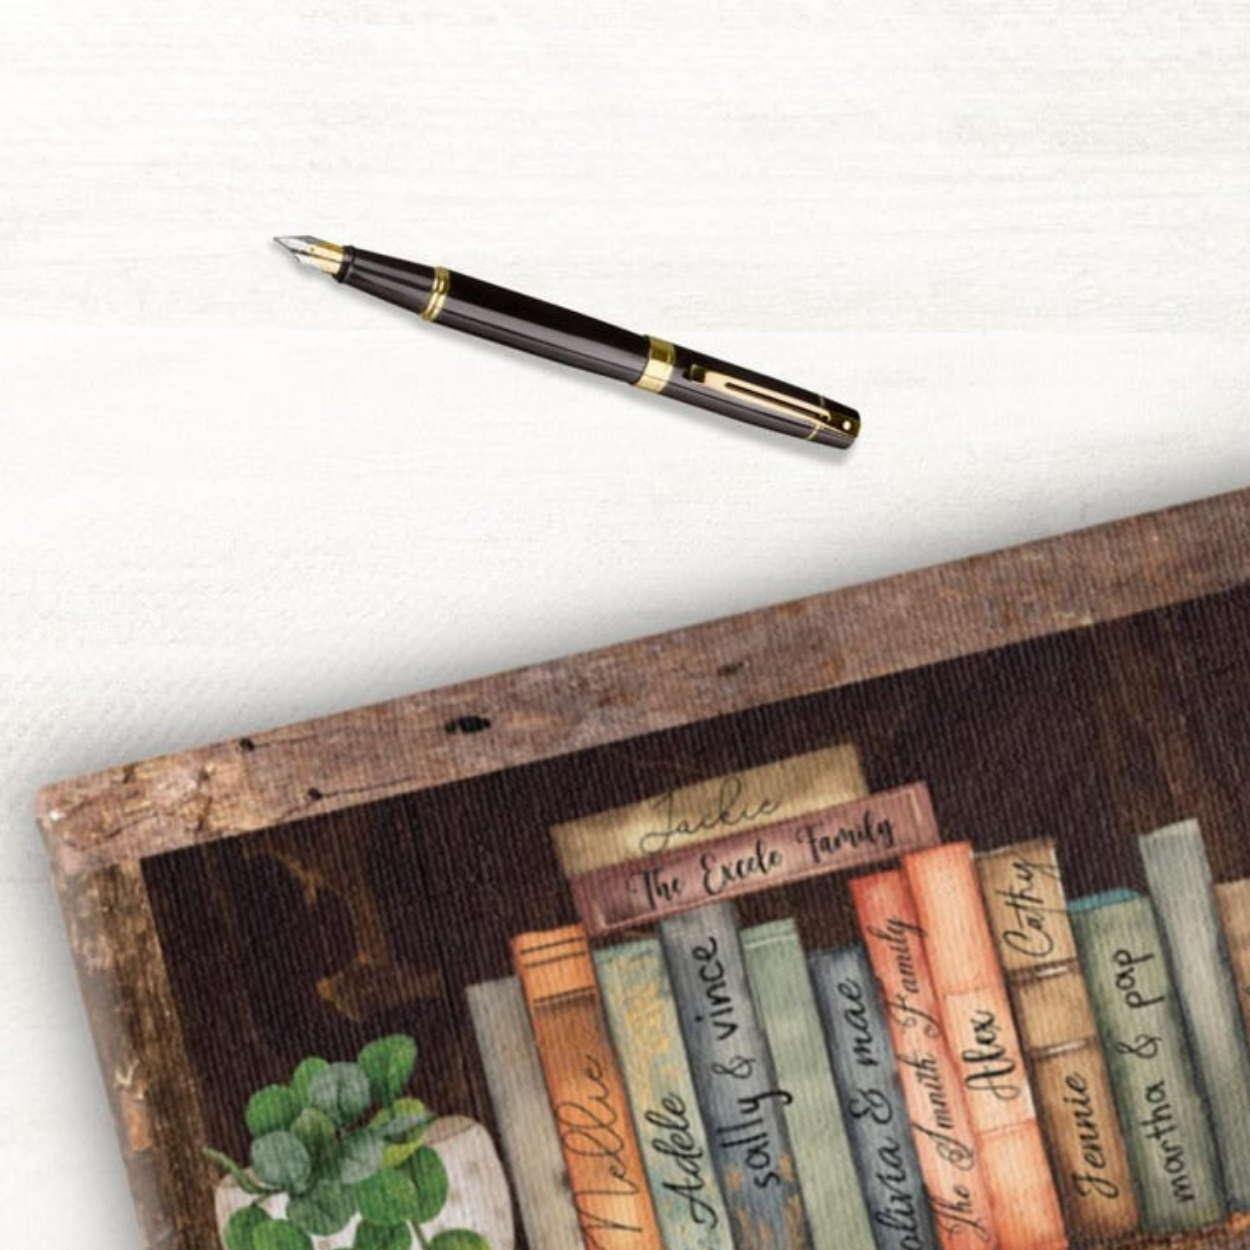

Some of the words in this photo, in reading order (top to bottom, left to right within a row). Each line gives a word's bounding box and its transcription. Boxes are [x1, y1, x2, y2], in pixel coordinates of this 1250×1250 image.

[630, 868, 684, 912] The
[795, 810, 896, 862] Family
[638, 776, 782, 854] Jackie
[1001, 855, 1062, 959] Cathy
[692, 935, 738, 1038] vince
[837, 979, 880, 1067] mae
[869, 914, 944, 1041] Family
[1113, 948, 1167, 1010] pap
[711, 1057, 755, 1080] &
[964, 1010, 1022, 1101] Alex
[1116, 1032, 1163, 1060] &
[713, 1087, 792, 1188] sally
[847, 1087, 894, 1125] &
[1067, 1072, 1119, 1199] Jennie
[1138, 1080, 1195, 1203] martha
[645, 1094, 719, 1230] Adele
[932, 1184, 992, 1243] The
